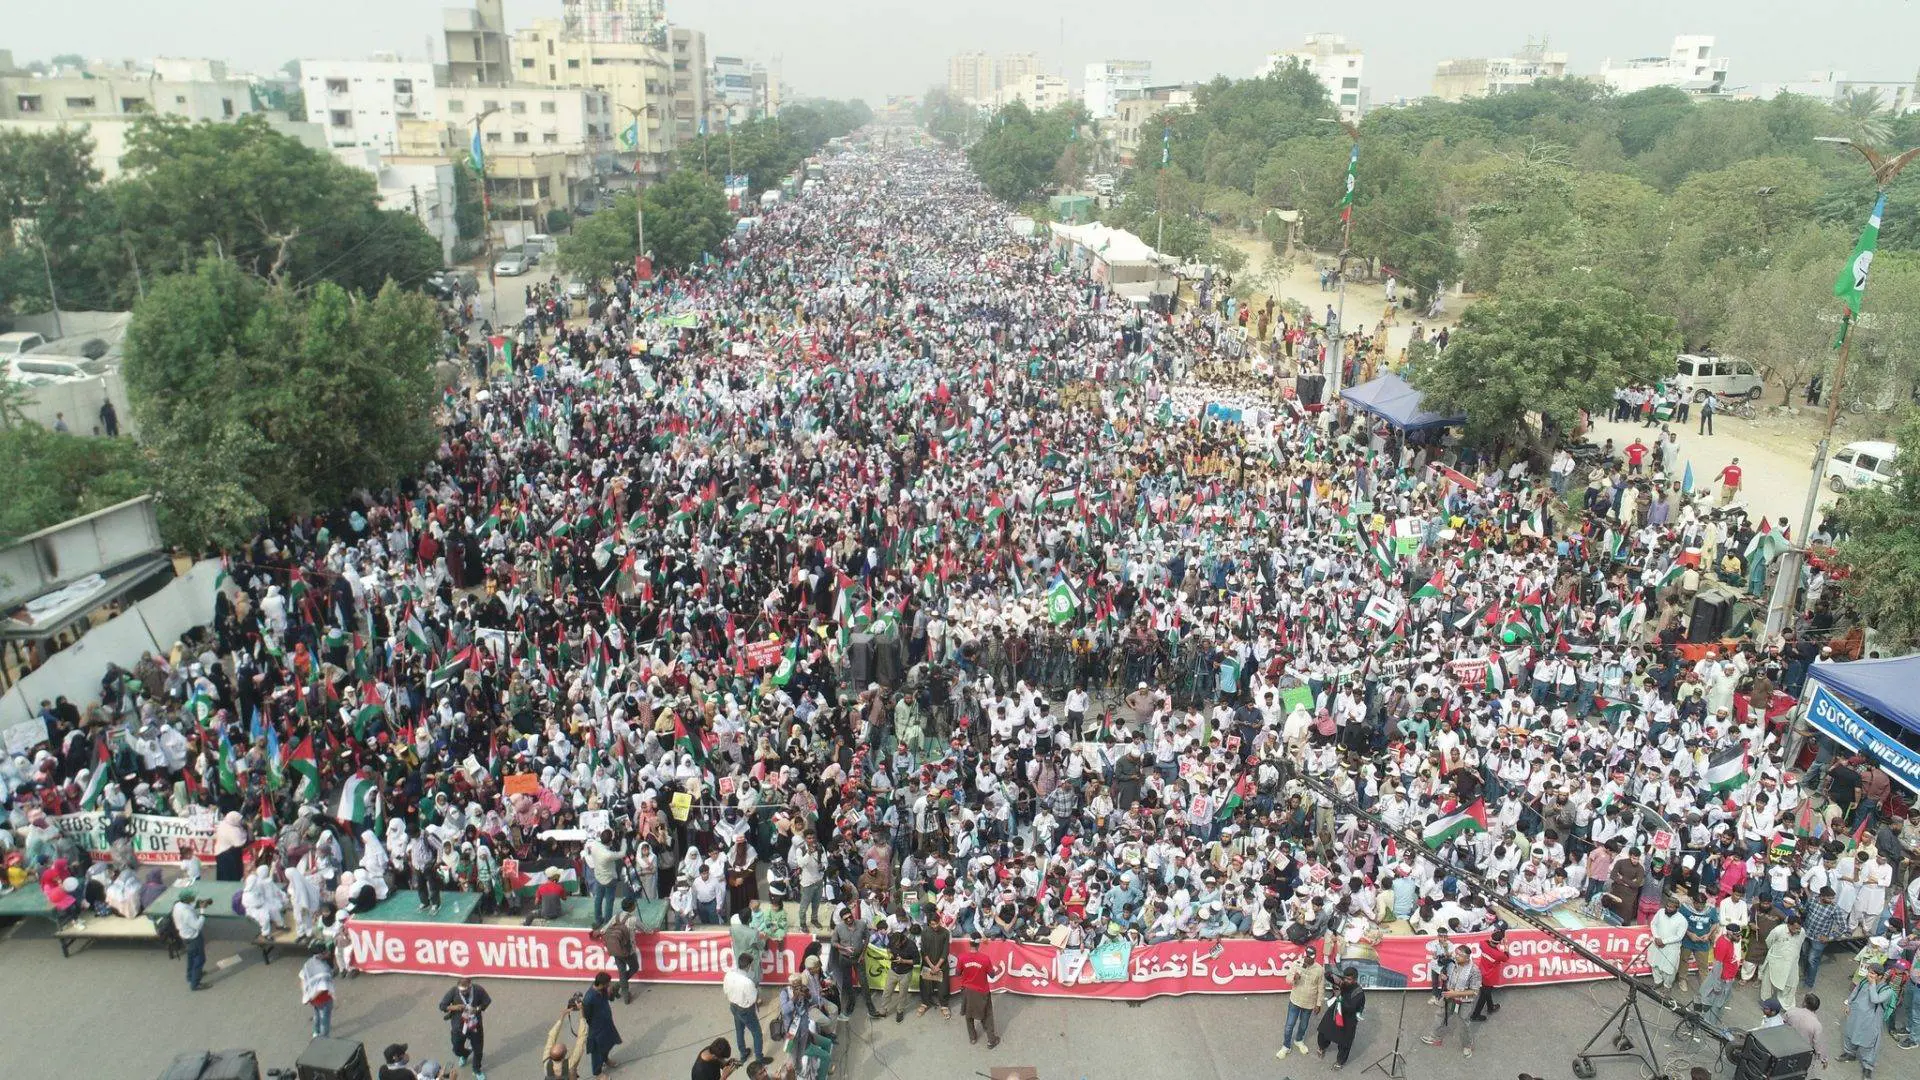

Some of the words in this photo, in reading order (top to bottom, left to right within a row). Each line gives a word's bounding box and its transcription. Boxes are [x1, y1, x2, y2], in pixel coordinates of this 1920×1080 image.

[1816, 699, 1865, 745] SOCIAL
[149, 835, 169, 851] OF
[348, 928, 406, 963] We
[415, 937, 470, 968] are
[477, 935, 550, 969] with
[1606, 933, 1630, 953] in
[1502, 962, 1533, 979] on
